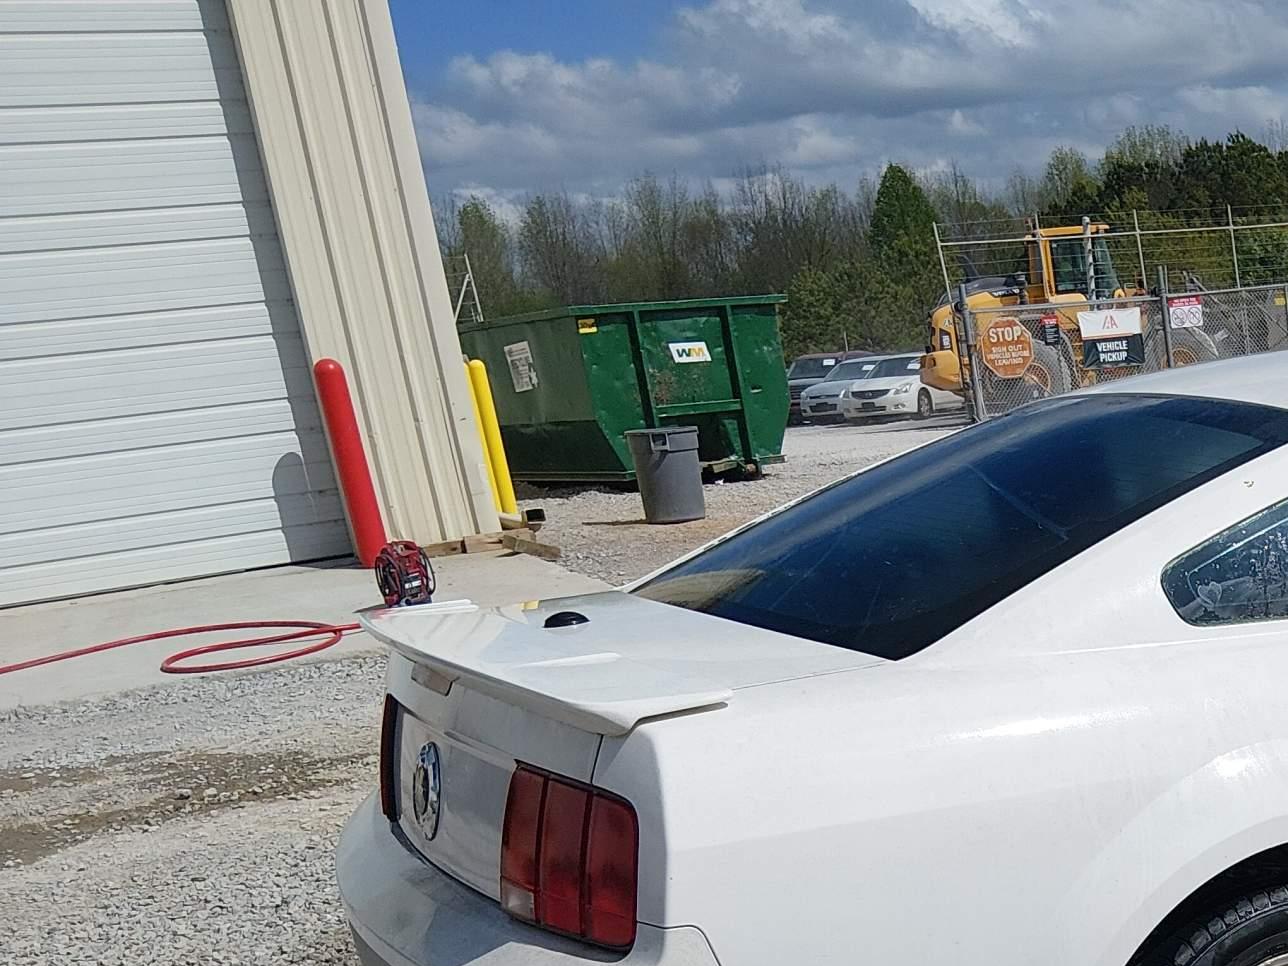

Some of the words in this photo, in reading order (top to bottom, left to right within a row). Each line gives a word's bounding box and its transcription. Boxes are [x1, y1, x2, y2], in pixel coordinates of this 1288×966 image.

[988, 326, 1022, 342] STOP
[1008, 344, 1023, 352] OUT
[1096, 340, 1128, 352] VEHICLE
[676, 347, 705, 358] WM
[1099, 351, 1128, 364] PICKUP
[994, 358, 1024, 366] LEAVING
